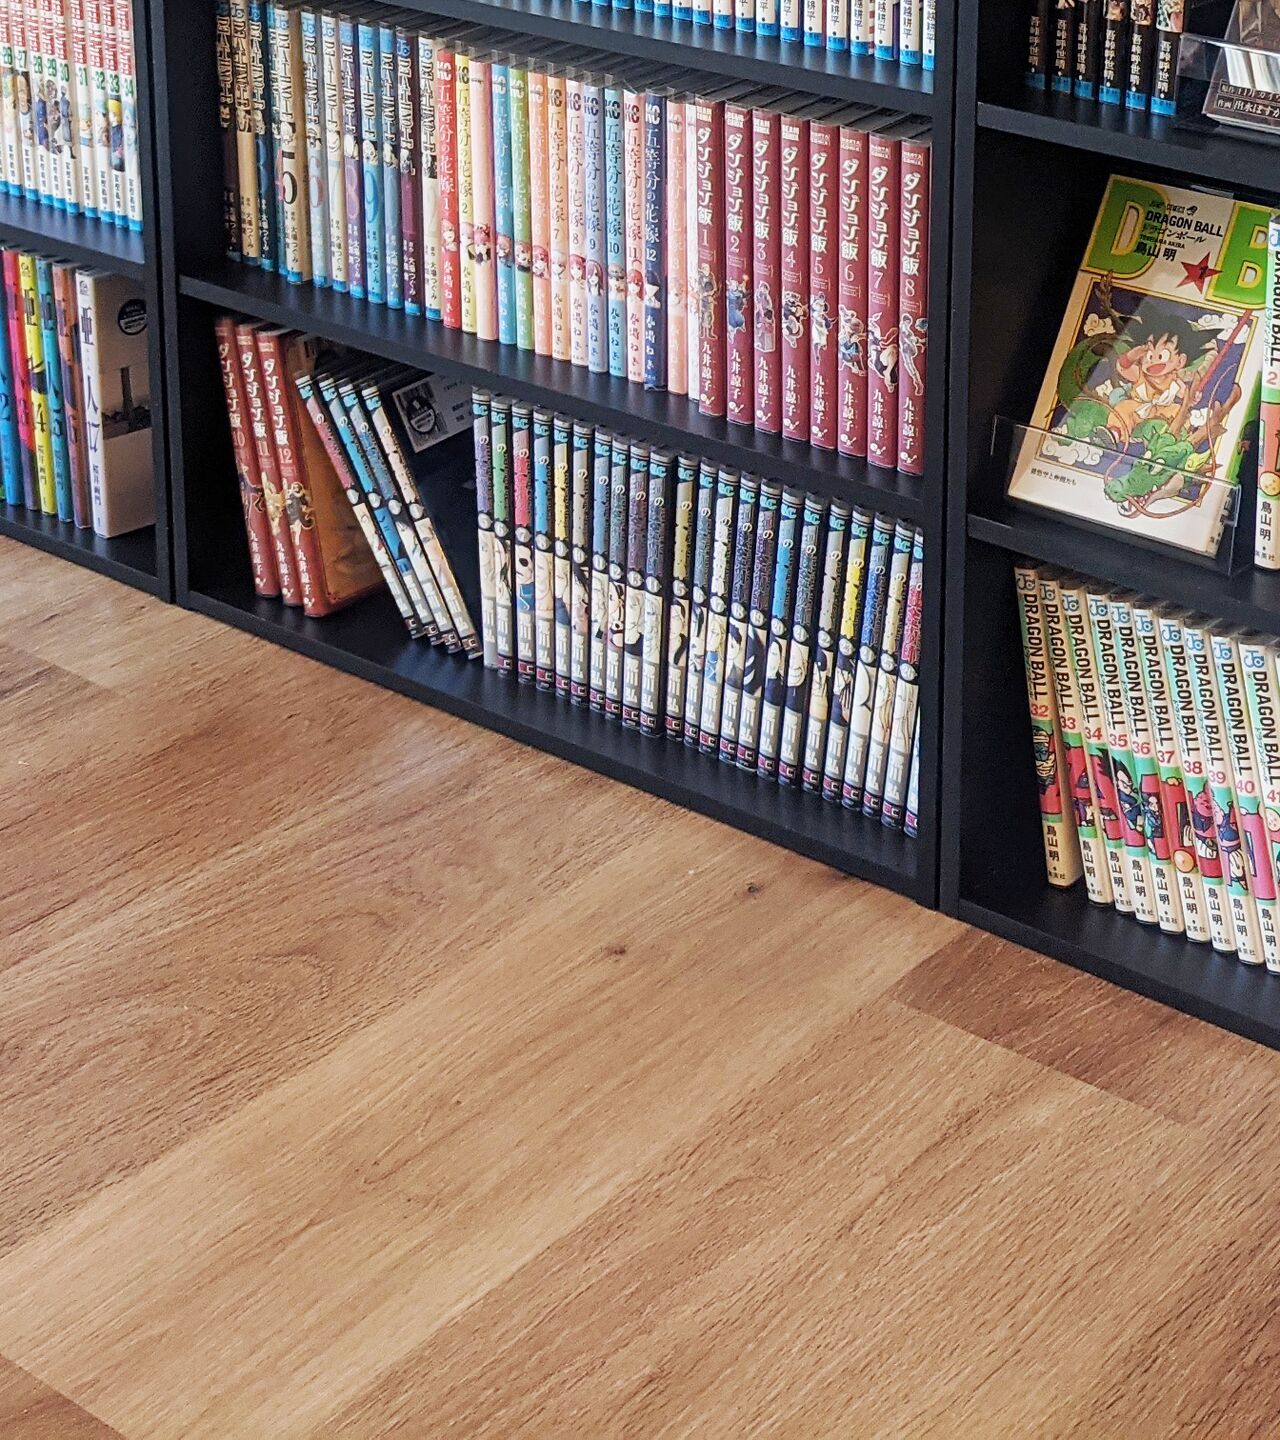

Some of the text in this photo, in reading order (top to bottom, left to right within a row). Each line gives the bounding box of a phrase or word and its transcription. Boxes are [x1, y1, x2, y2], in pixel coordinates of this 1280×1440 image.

[438, 85, 455, 194] 五等分の花嫁
[646, 129, 661, 244] 五等分の花嫁
[697, 127, 713, 226] ダンジョン飯
[781, 146, 800, 248] ダンジョン飯
[902, 172, 922, 277] ダンジョン飯
[1145, 210, 1223, 237] DRAGON BALL
[608, 240, 620, 254] 10
[646, 248, 657, 261] 12
[784, 251, 796, 269] 4
[844, 264, 854, 282] 6
[905, 278, 915, 297] 8
[263, 359, 289, 445] ダンジョン飯
[278, 448, 292, 463] 12
[1169, 644, 1201, 757] DRAGON BALL
[1184, 760, 1203, 775] 38
